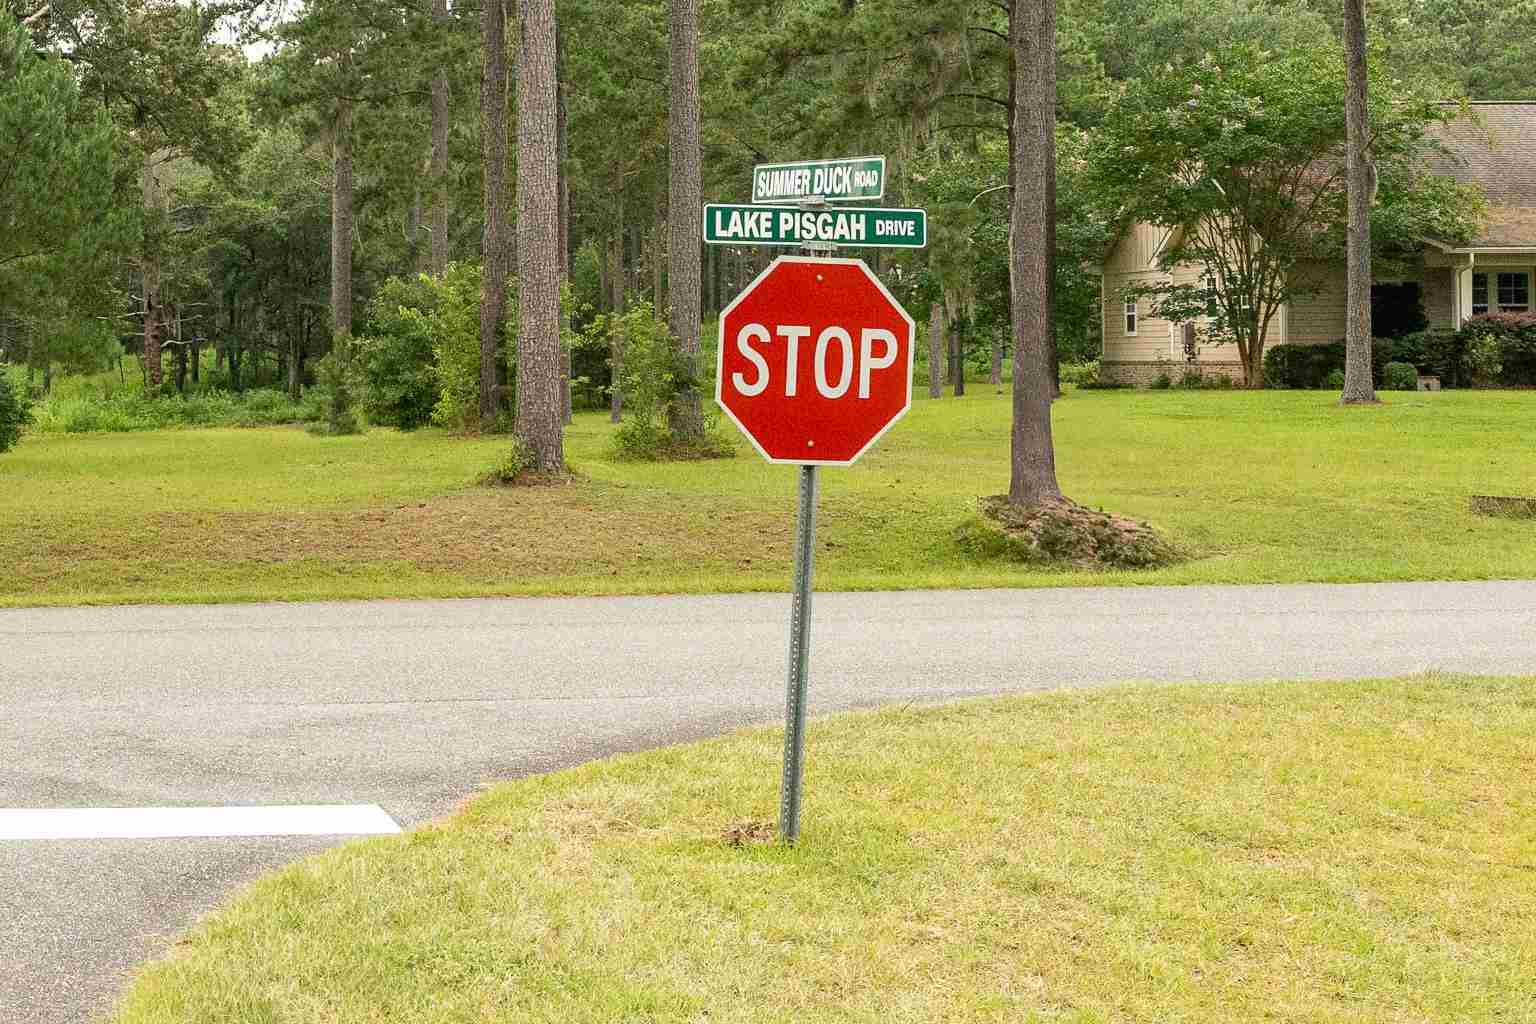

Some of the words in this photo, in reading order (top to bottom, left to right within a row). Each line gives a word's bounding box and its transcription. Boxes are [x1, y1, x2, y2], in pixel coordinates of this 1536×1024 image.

[757, 169, 811, 197] SUMMER
[814, 166, 852, 195] DUCK
[854, 169, 878, 188] ROAD
[715, 210, 773, 238] LAKE
[779, 212, 866, 241] PISGAH
[876, 219, 915, 237] DRIVE
[732, 323, 898, 399] STOP
